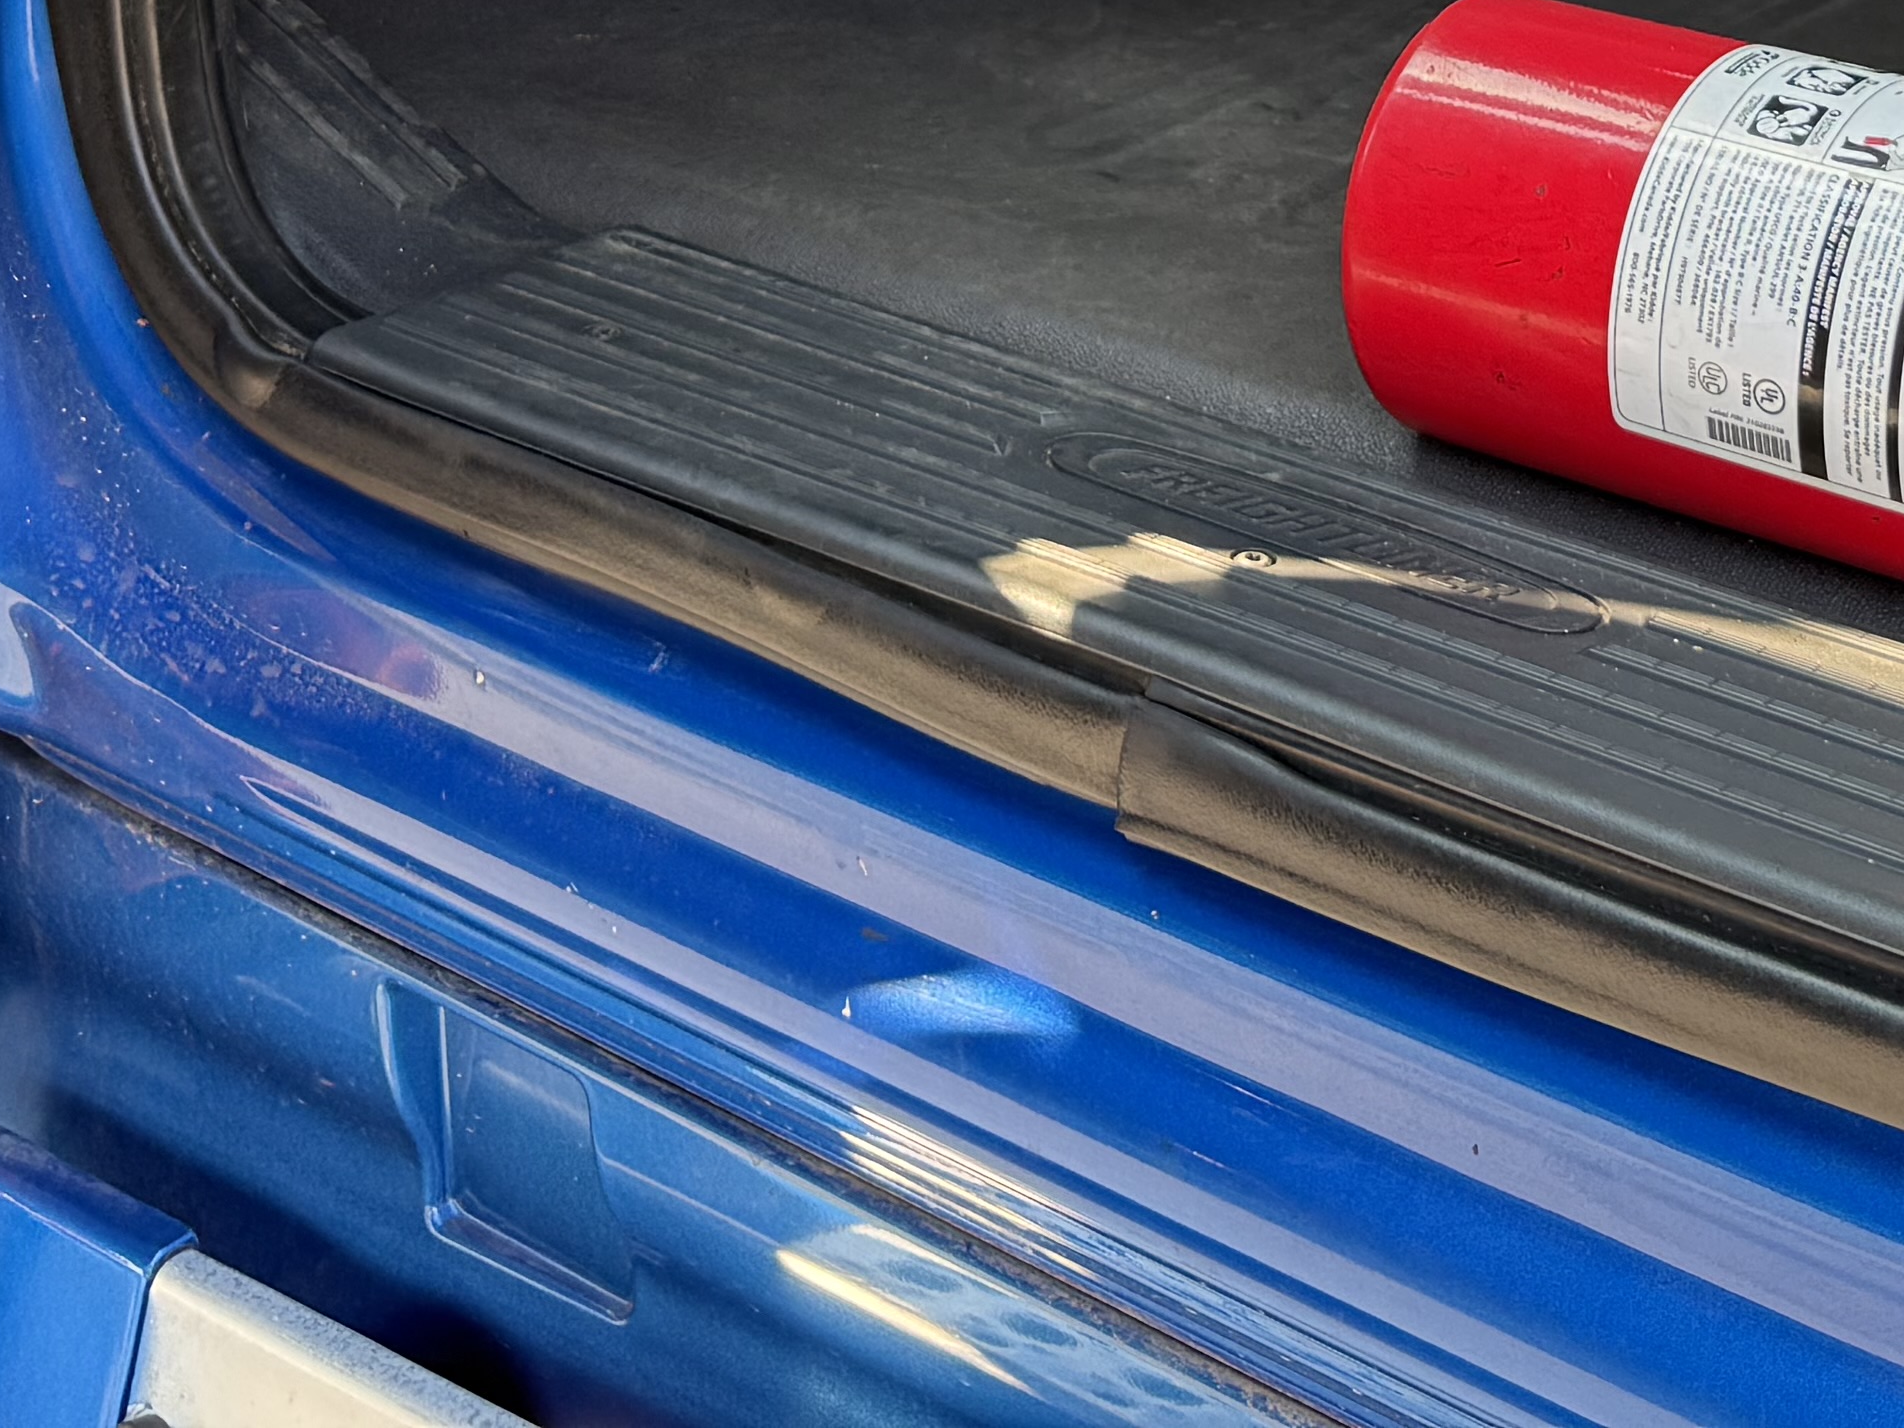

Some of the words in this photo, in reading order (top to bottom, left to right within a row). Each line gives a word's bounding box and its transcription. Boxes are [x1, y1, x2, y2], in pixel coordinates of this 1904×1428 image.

[1687, 355, 1695, 389] LISTED
[1702, 364, 1721, 392] ULC
[1742, 371, 1750, 408] LISTED
[1122, 462, 1521, 599] FREIGHTLINER
